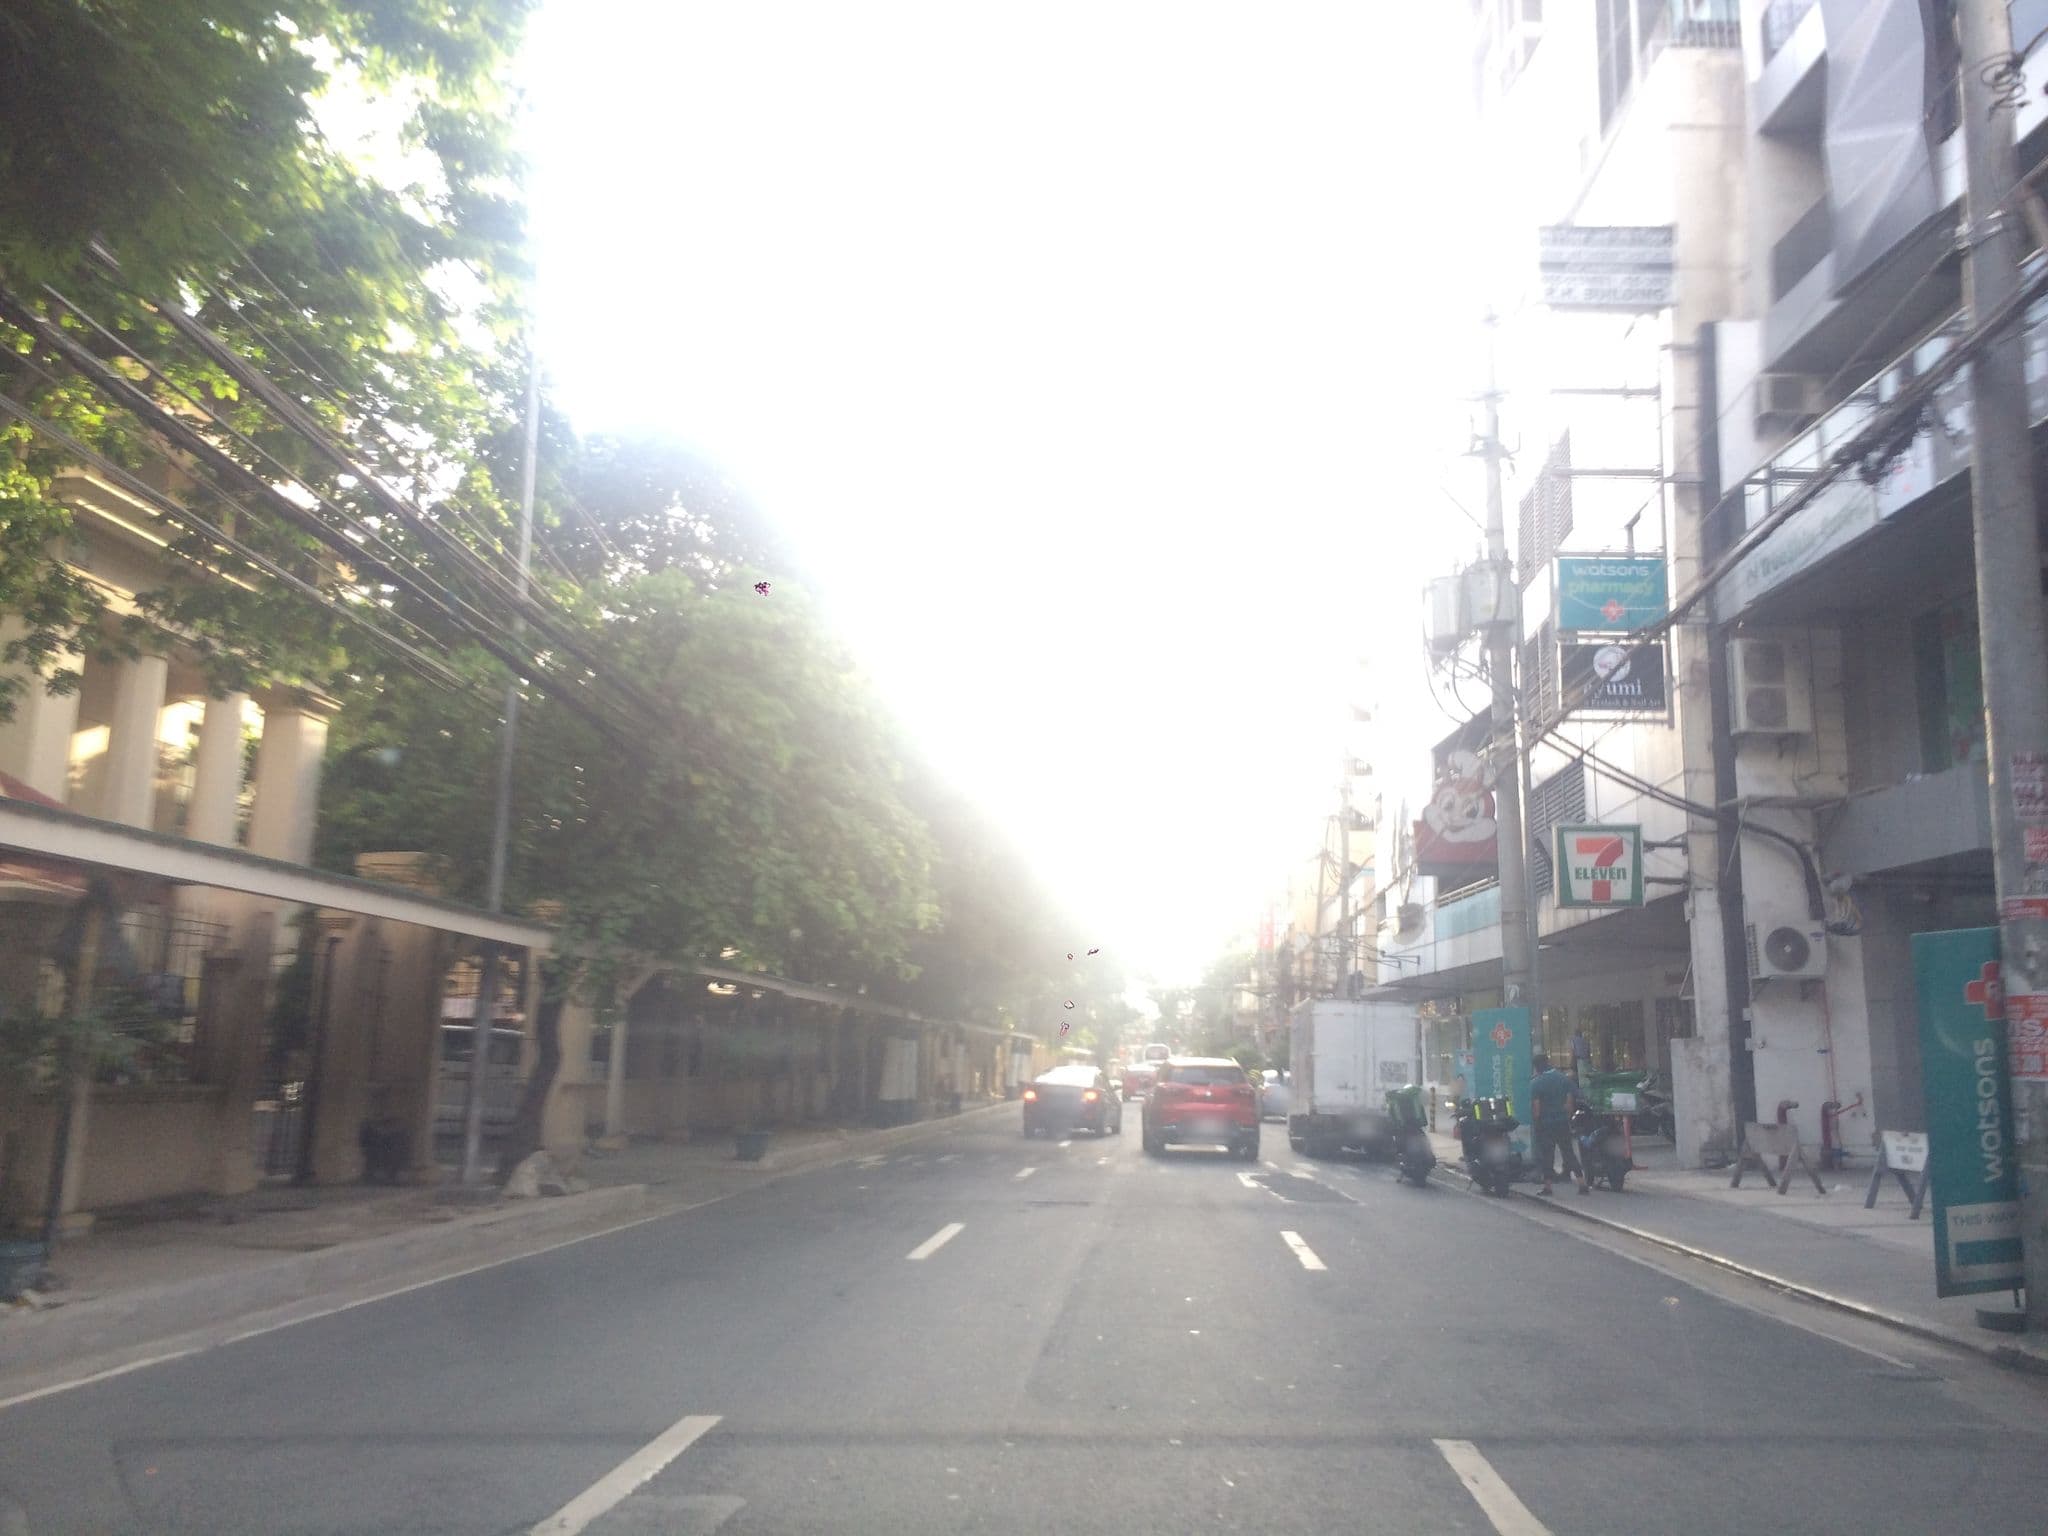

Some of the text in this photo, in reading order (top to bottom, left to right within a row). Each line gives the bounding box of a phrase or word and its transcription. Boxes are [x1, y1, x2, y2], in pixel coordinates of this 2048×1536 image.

[1571, 563, 1649, 577] watsons
[1567, 579, 1655, 597] pharmacy
[1974, 1038, 2003, 1182] watsons
